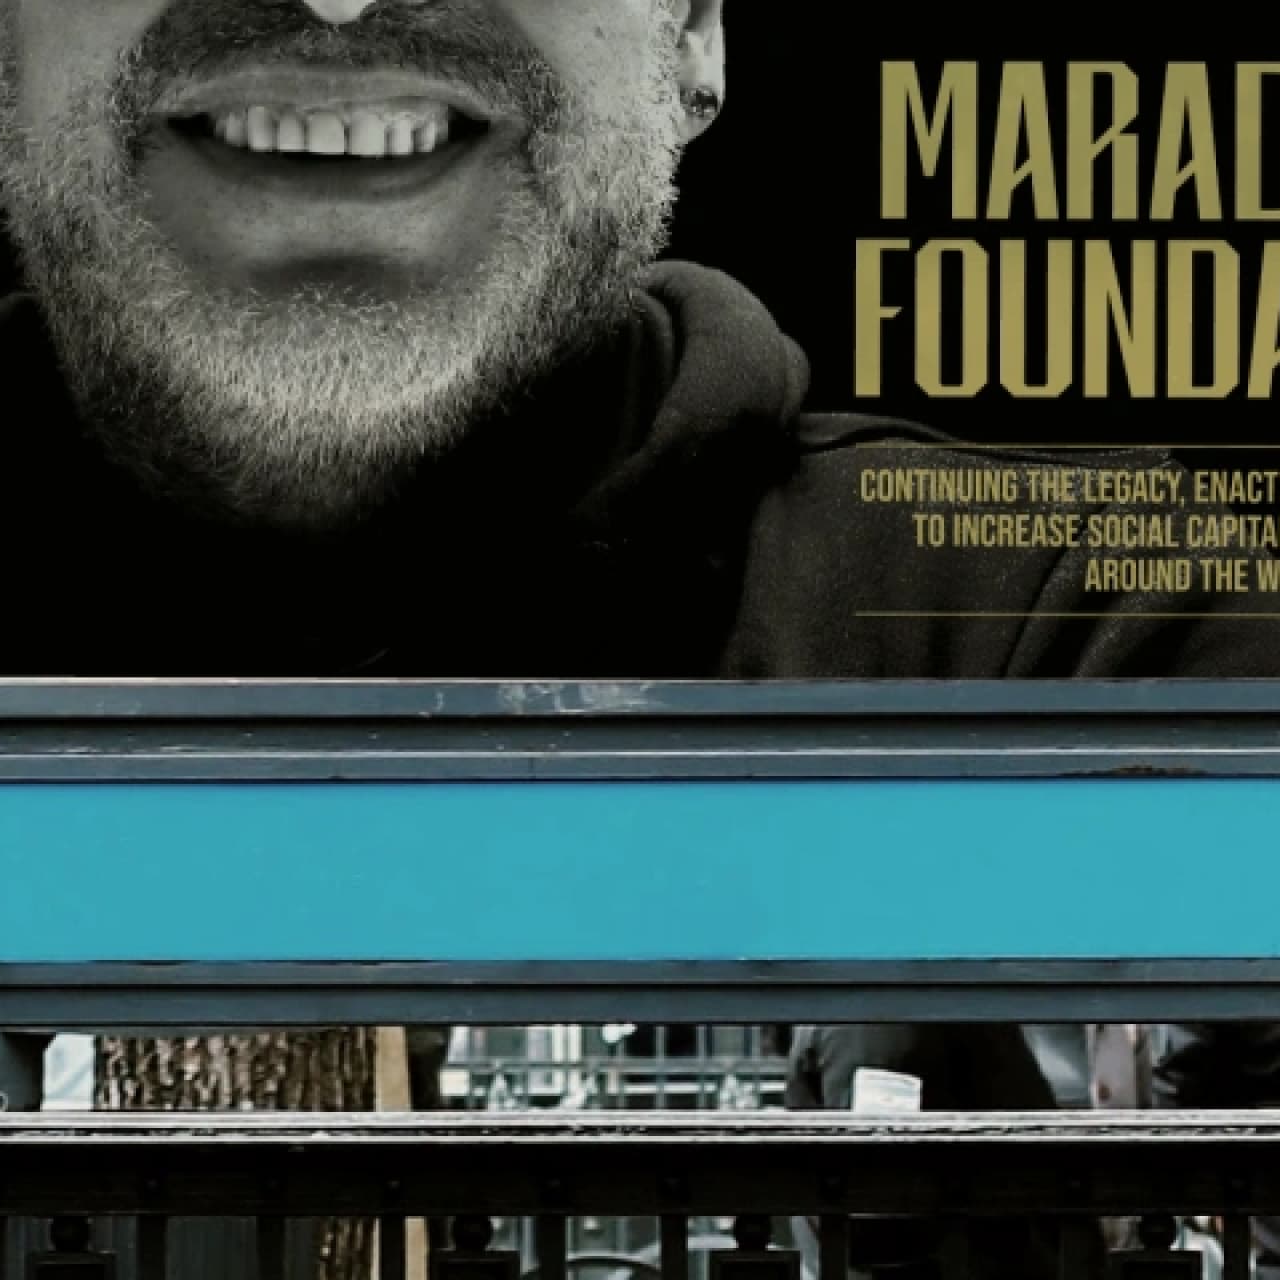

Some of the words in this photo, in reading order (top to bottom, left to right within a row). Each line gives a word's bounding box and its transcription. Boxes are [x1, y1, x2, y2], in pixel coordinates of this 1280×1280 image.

[859, 468, 1019, 503] CONTINUING
[1025, 469, 1076, 503] THE
[1082, 469, 1186, 509] LEGACY,
[911, 513, 945, 547] TO
[953, 513, 1081, 548] INCREASE
[1086, 513, 1180, 549] SOCIAL
[1084, 558, 1193, 593] AROUND
[1199, 558, 1250, 593] THE
